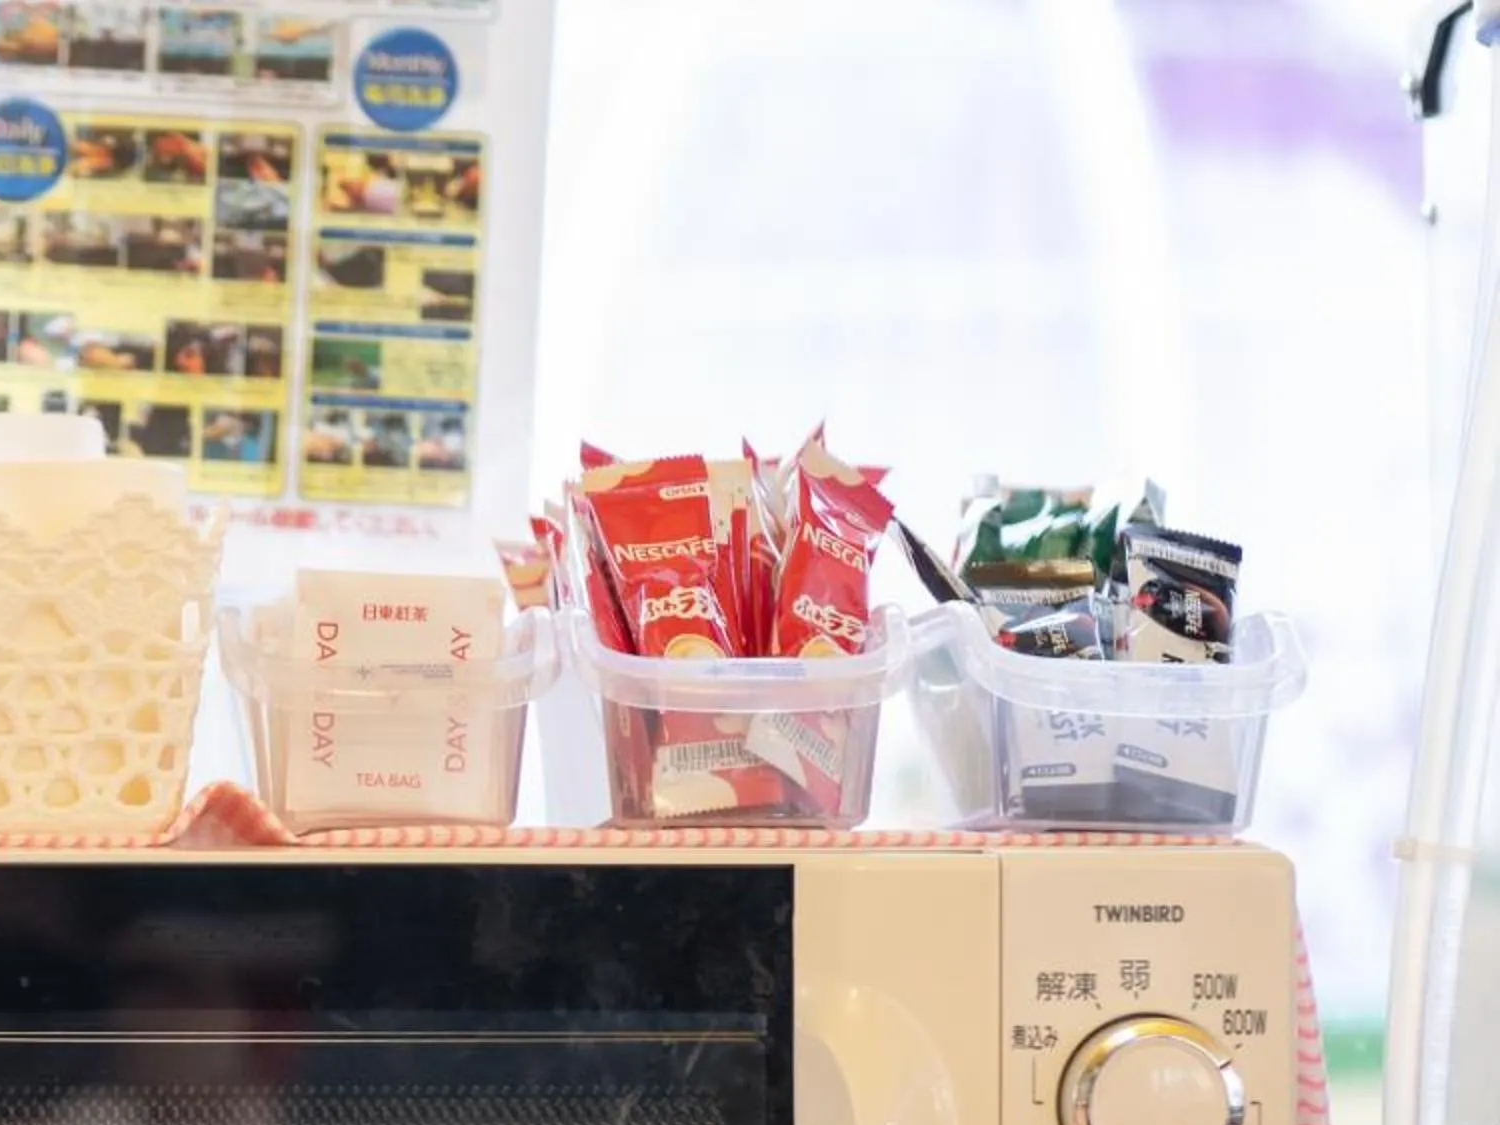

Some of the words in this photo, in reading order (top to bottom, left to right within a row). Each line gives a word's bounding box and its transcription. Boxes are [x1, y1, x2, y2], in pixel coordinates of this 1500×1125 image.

[803, 522, 866, 572] NESCA
[362, 603, 429, 622] 日東紅茶
[316, 621, 339, 661] DA
[450, 626, 473, 661] AY
[312, 712, 335, 769] DAY
[444, 716, 468, 773] DAY
[356, 773, 385, 788] TEA
[388, 774, 421, 789] BAG
[1093, 904, 1185, 923] TWINBIRD
[1036, 972, 1098, 1001] 解凍
[1120, 960, 1150, 991] 弱
[1193, 974, 1238, 1000] 500W
[1223, 1009, 1268, 1035] 600W
[1012, 1025, 1059, 1050] 煮込み
